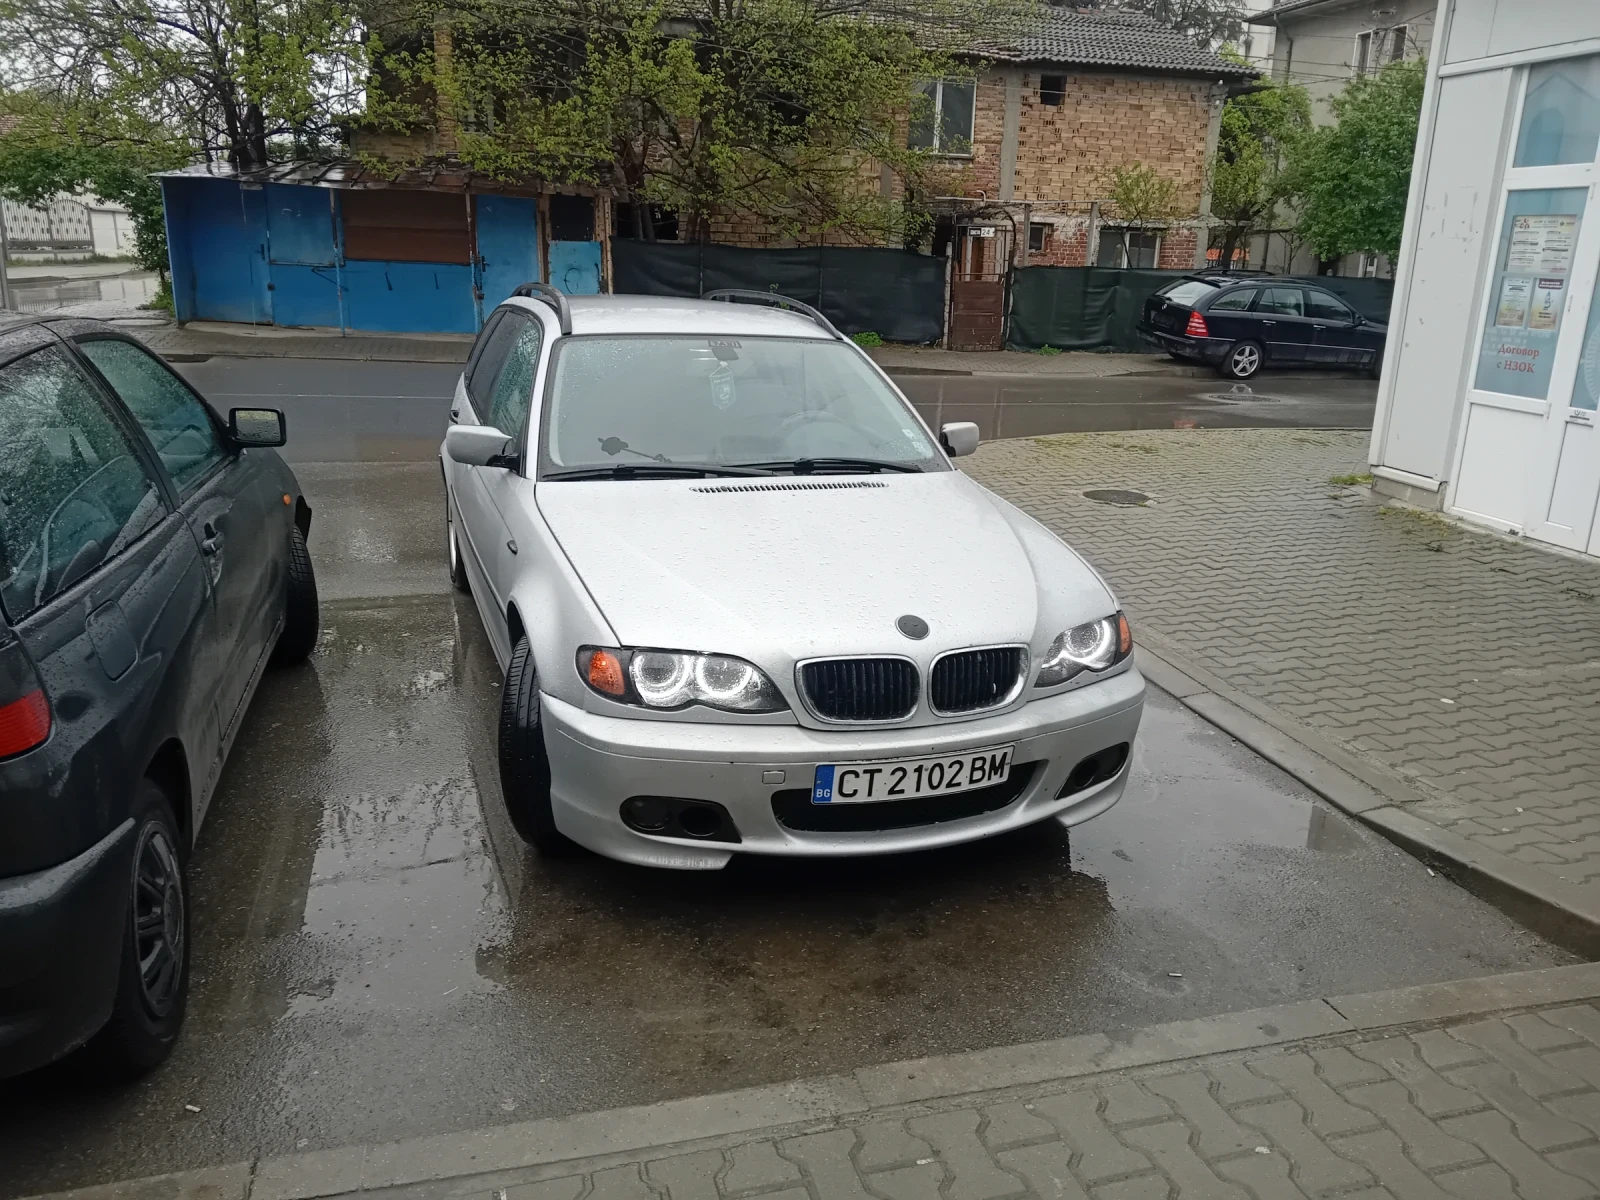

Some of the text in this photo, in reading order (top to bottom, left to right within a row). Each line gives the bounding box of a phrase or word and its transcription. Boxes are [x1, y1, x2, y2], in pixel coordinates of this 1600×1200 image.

[1498, 344, 1540, 360] Договор
[1496, 360, 1536, 373] с НЗОК
[816, 788, 831, 798] BG
